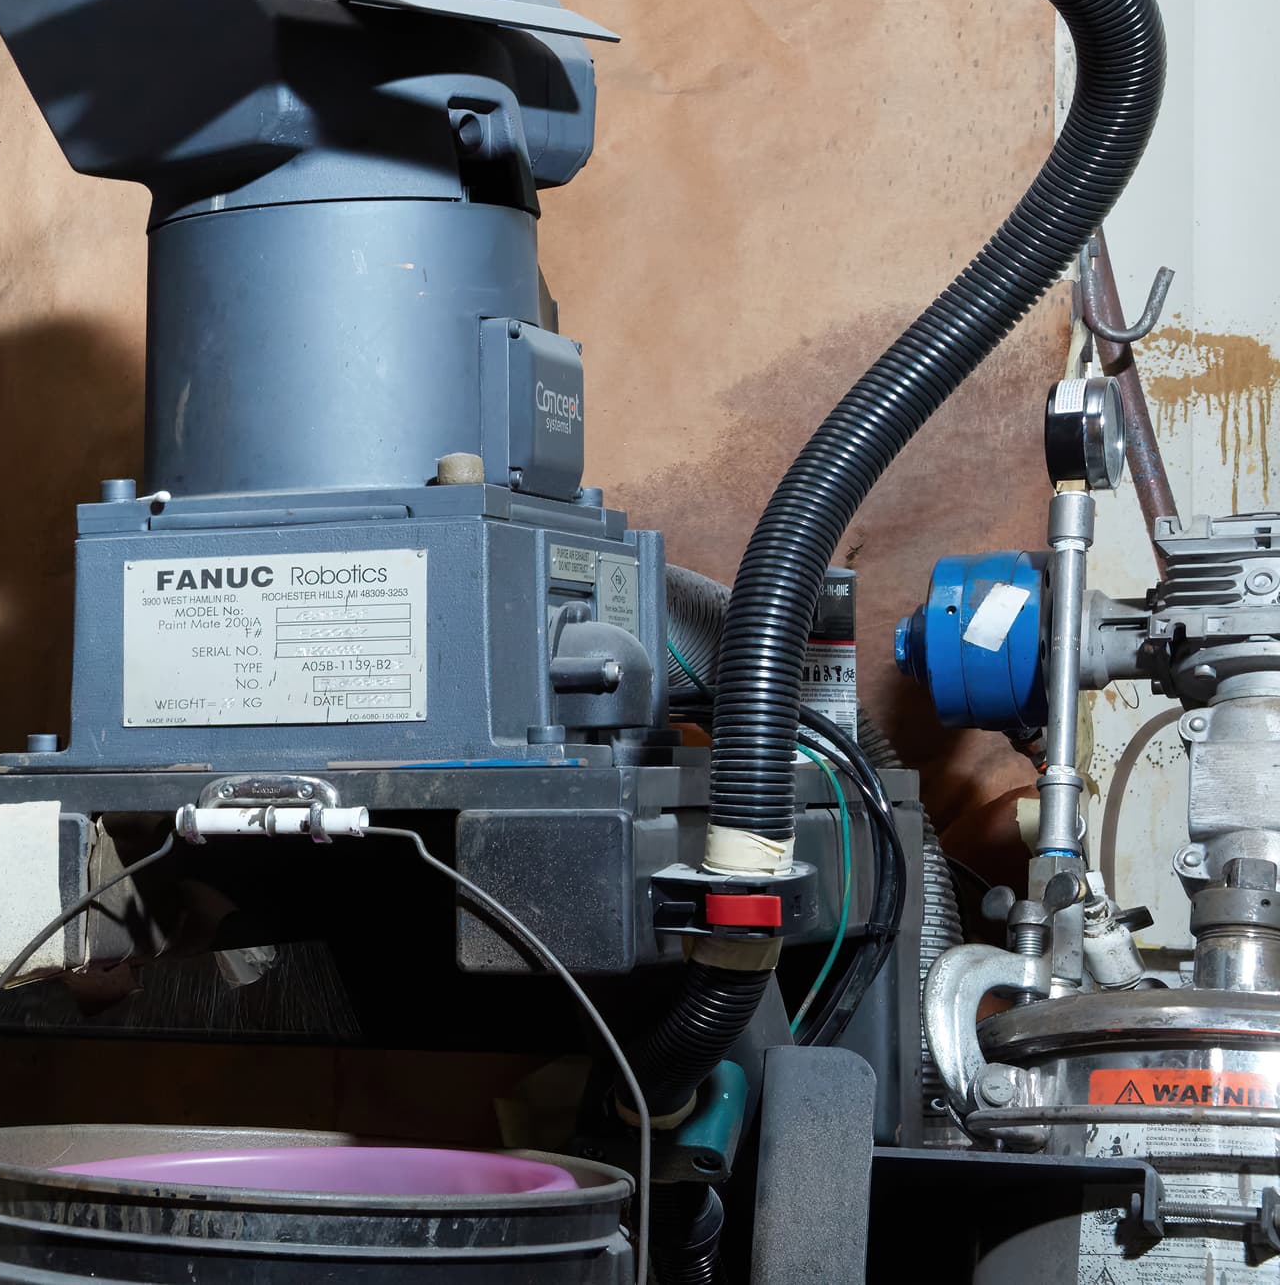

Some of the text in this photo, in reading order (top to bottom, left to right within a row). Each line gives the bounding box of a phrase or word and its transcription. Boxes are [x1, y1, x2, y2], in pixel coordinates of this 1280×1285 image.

[535, 380, 582, 434] Concept
[546, 417, 569, 434] systems
[156, 564, 388, 591] FANUC Robotics
[142, 593, 239, 607] 3900 WEST HAMLIN RD.
[261, 589, 316, 602] ROCHESTER
[347, 588, 359, 599] MI
[360, 587, 409, 599] 48309-3253
[175, 606, 244, 618] MODEL No:
[158, 616, 262, 630] Paint Mate 200iA
[192, 645, 262, 658] SERIAL NO.
[234, 662, 263, 673] TYPE
[236, 678, 262, 690] NO.
[242, 697, 262, 708] KG
[313, 695, 345, 706] DATE
